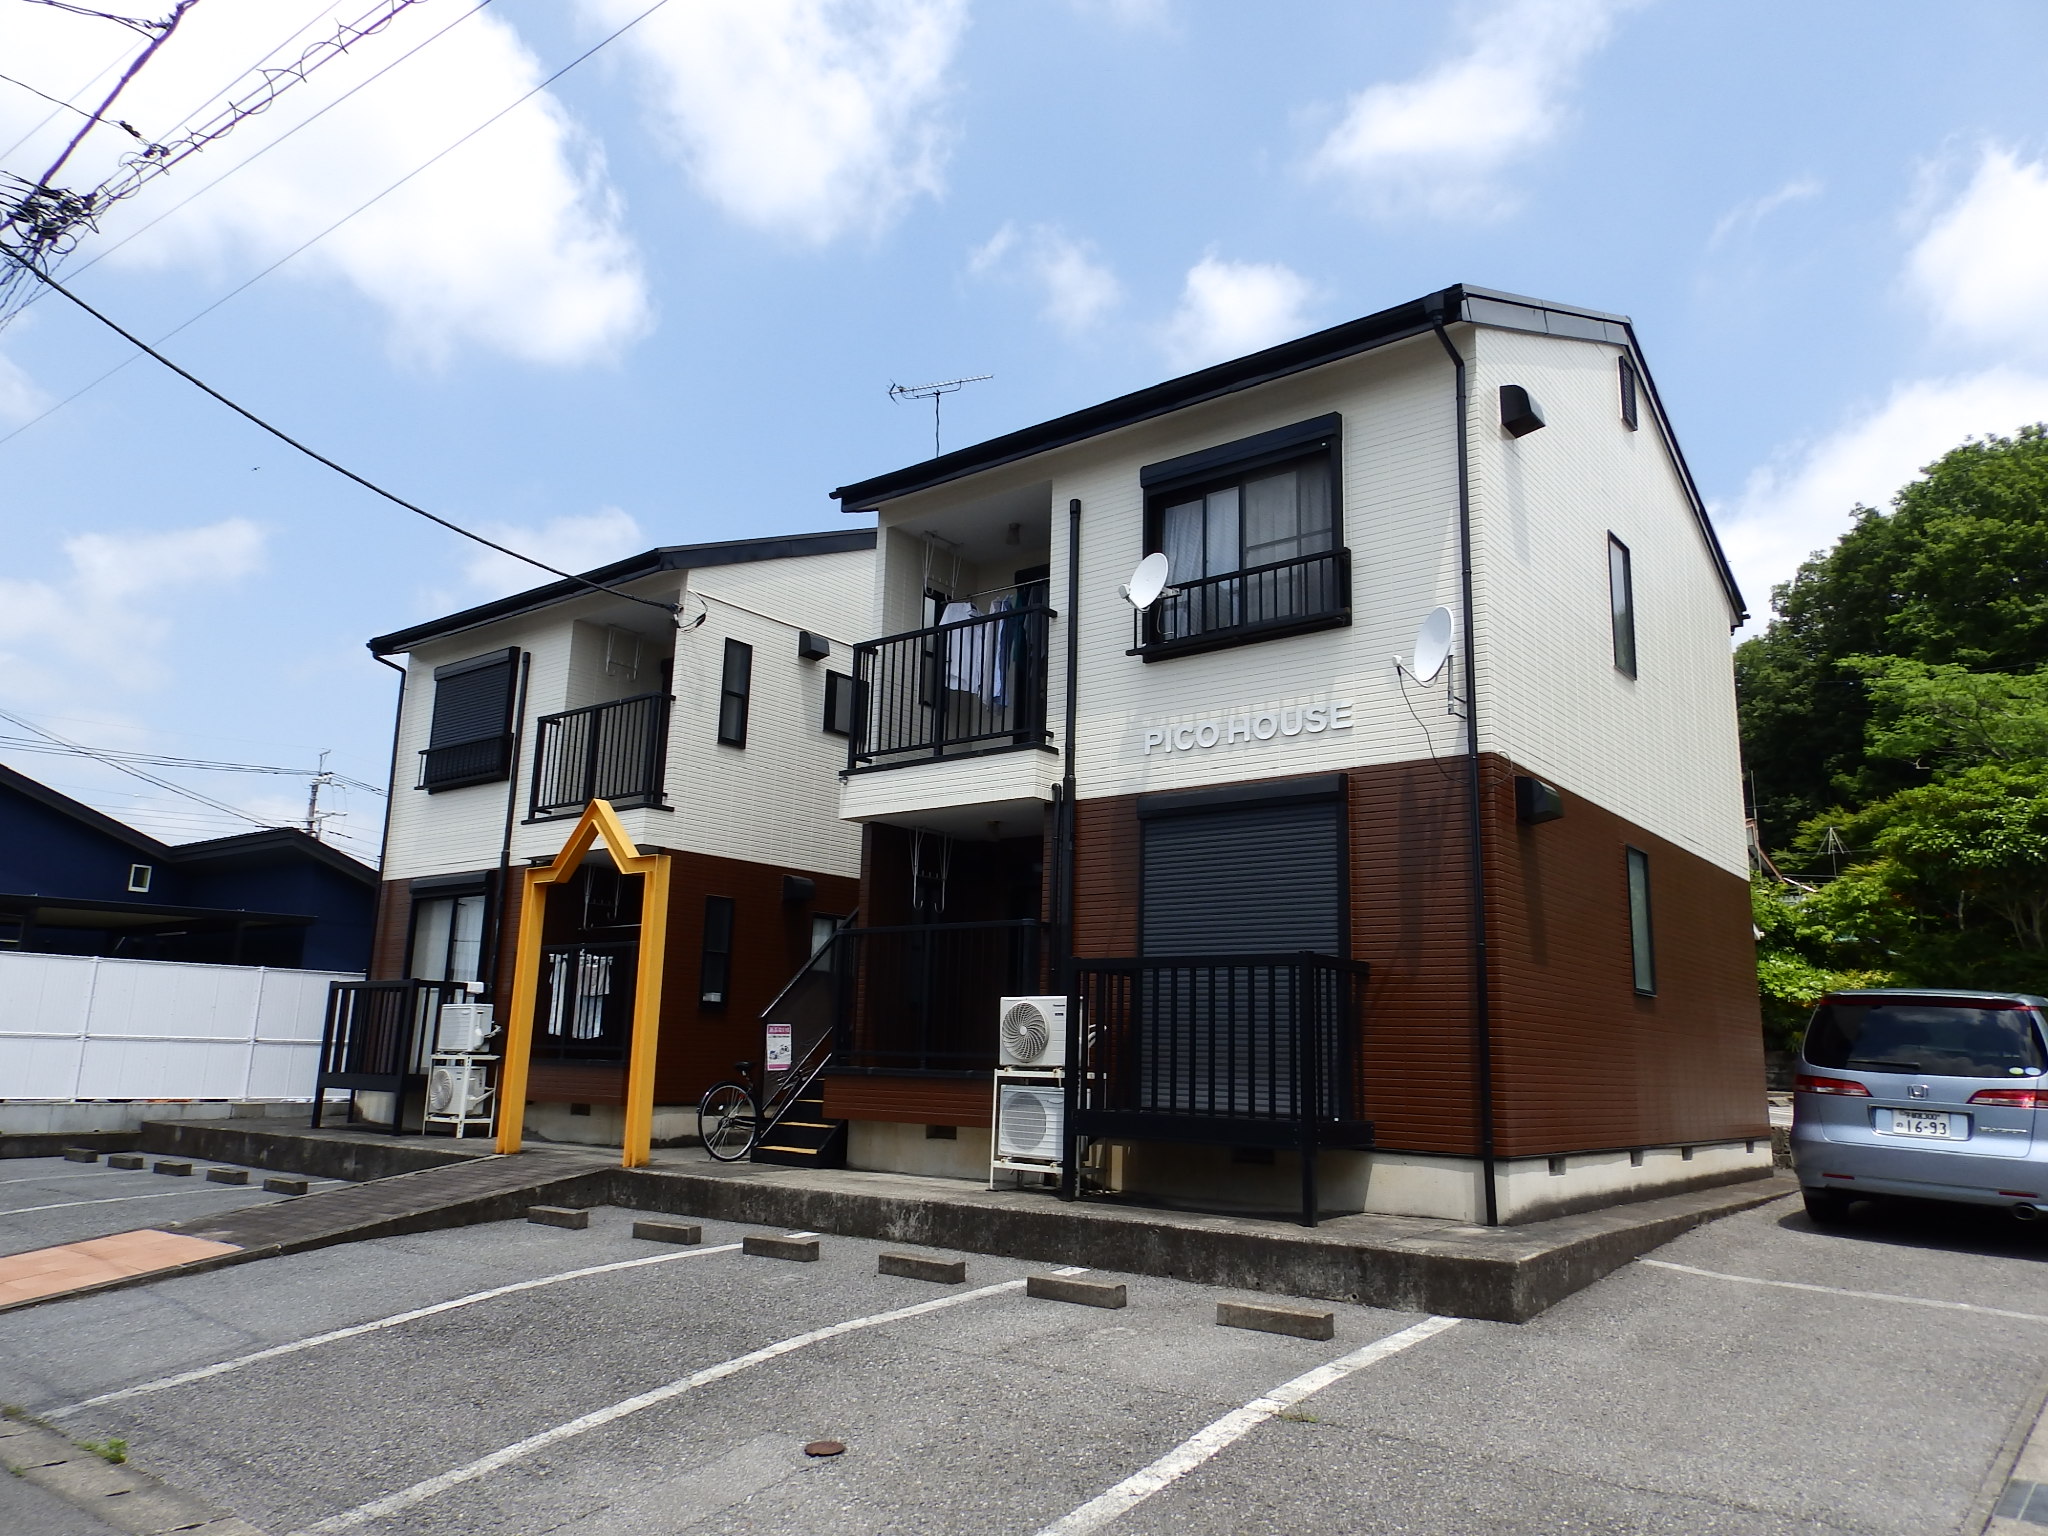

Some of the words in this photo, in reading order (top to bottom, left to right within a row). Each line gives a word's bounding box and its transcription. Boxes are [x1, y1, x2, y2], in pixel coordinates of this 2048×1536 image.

[1144, 720, 1220, 755] PICO
[1227, 701, 1353, 744] HOUSE
[1907, 1120, 1947, 1135] 16-93
